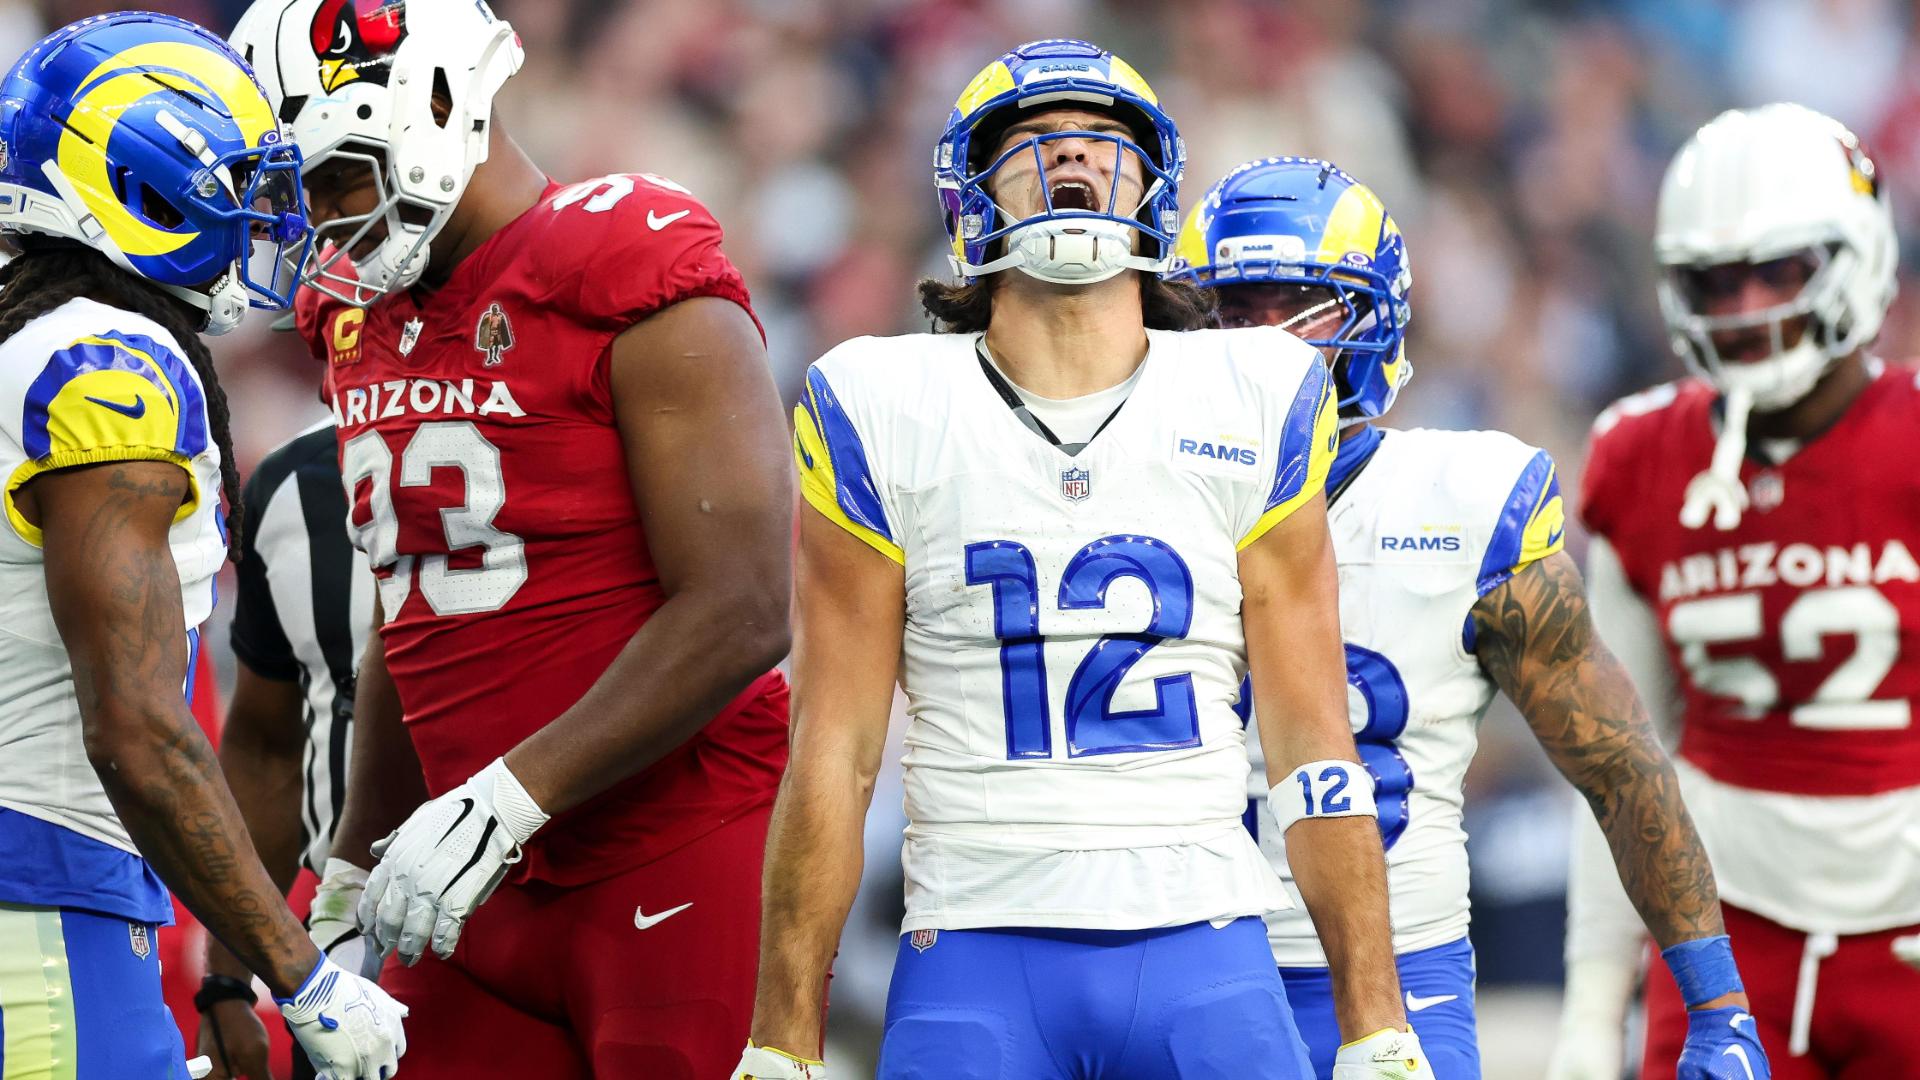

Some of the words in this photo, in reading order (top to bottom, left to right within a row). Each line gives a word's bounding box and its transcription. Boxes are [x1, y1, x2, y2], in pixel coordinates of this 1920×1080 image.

[332, 378, 527, 429] ARIZONA
[1179, 438, 1257, 466] RAMS
[1065, 481, 1087, 497] NFL
[342, 421, 529, 624] 93
[1381, 536, 1461, 551] RAMS
[1659, 538, 1920, 602] ARIZONA
[964, 533, 1203, 760] 12
[1669, 586, 1911, 729] 52
[1296, 766, 1352, 815] 12
